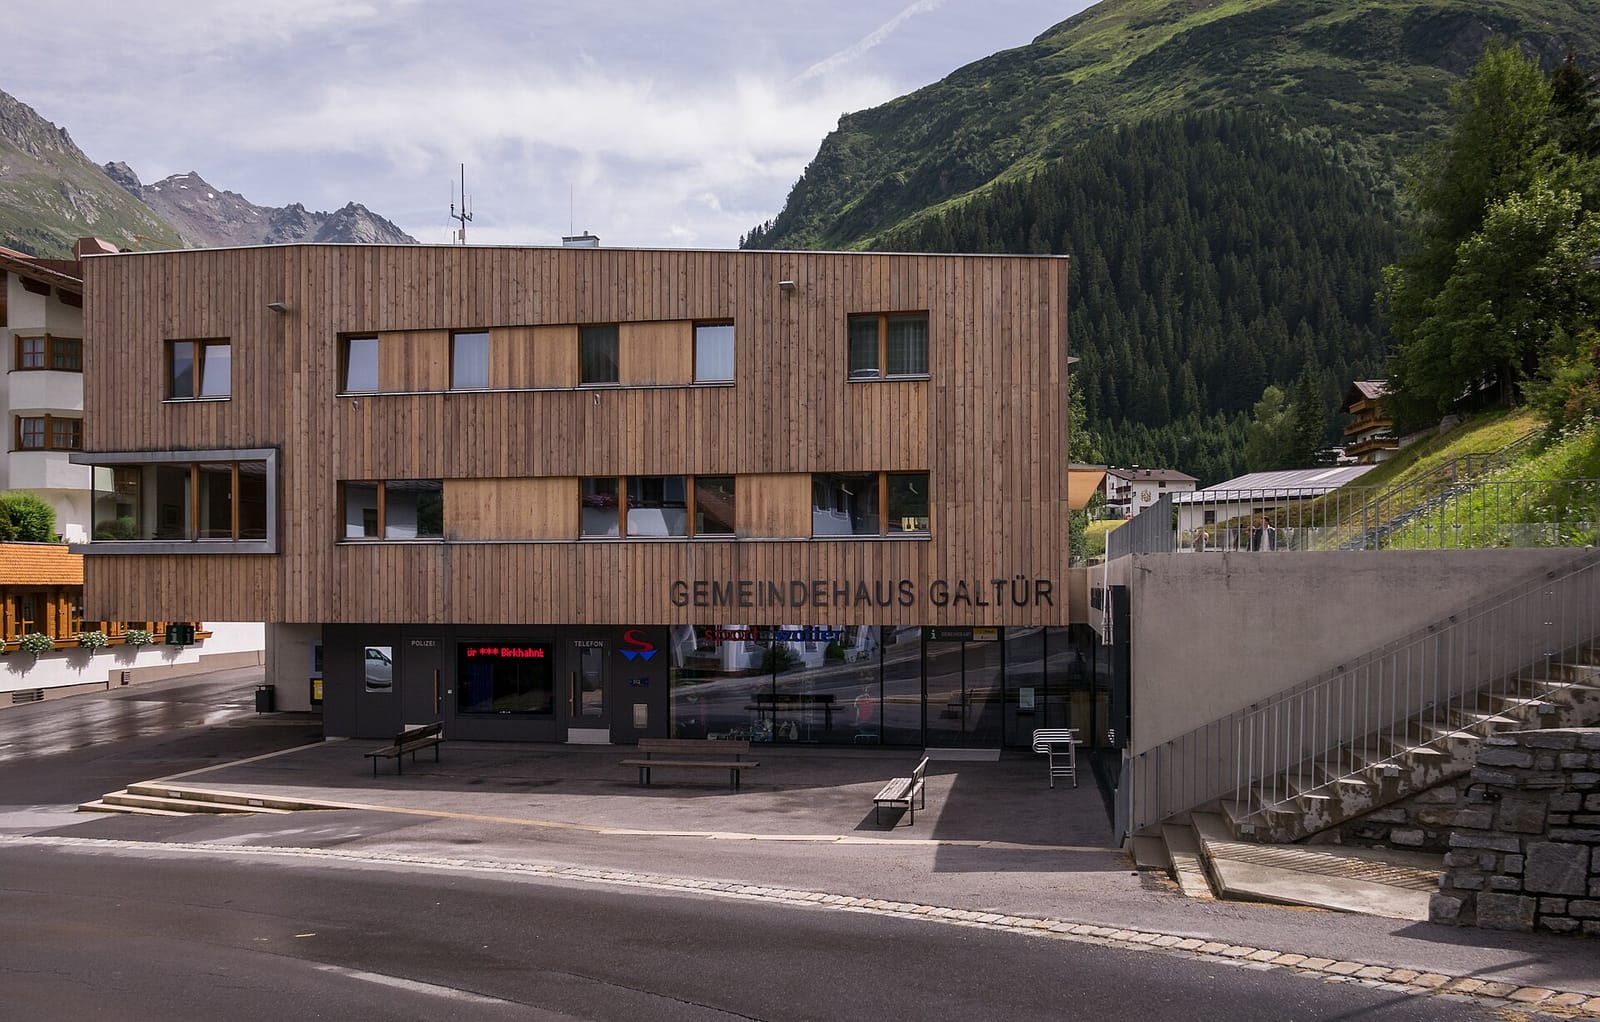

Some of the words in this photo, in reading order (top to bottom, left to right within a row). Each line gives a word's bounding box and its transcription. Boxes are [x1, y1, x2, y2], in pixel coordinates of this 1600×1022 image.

[670, 579, 915, 607] GEMEINDEHAUS
[929, 574, 1054, 607] GALTÜR
[573, 640, 604, 648] TELEFON
